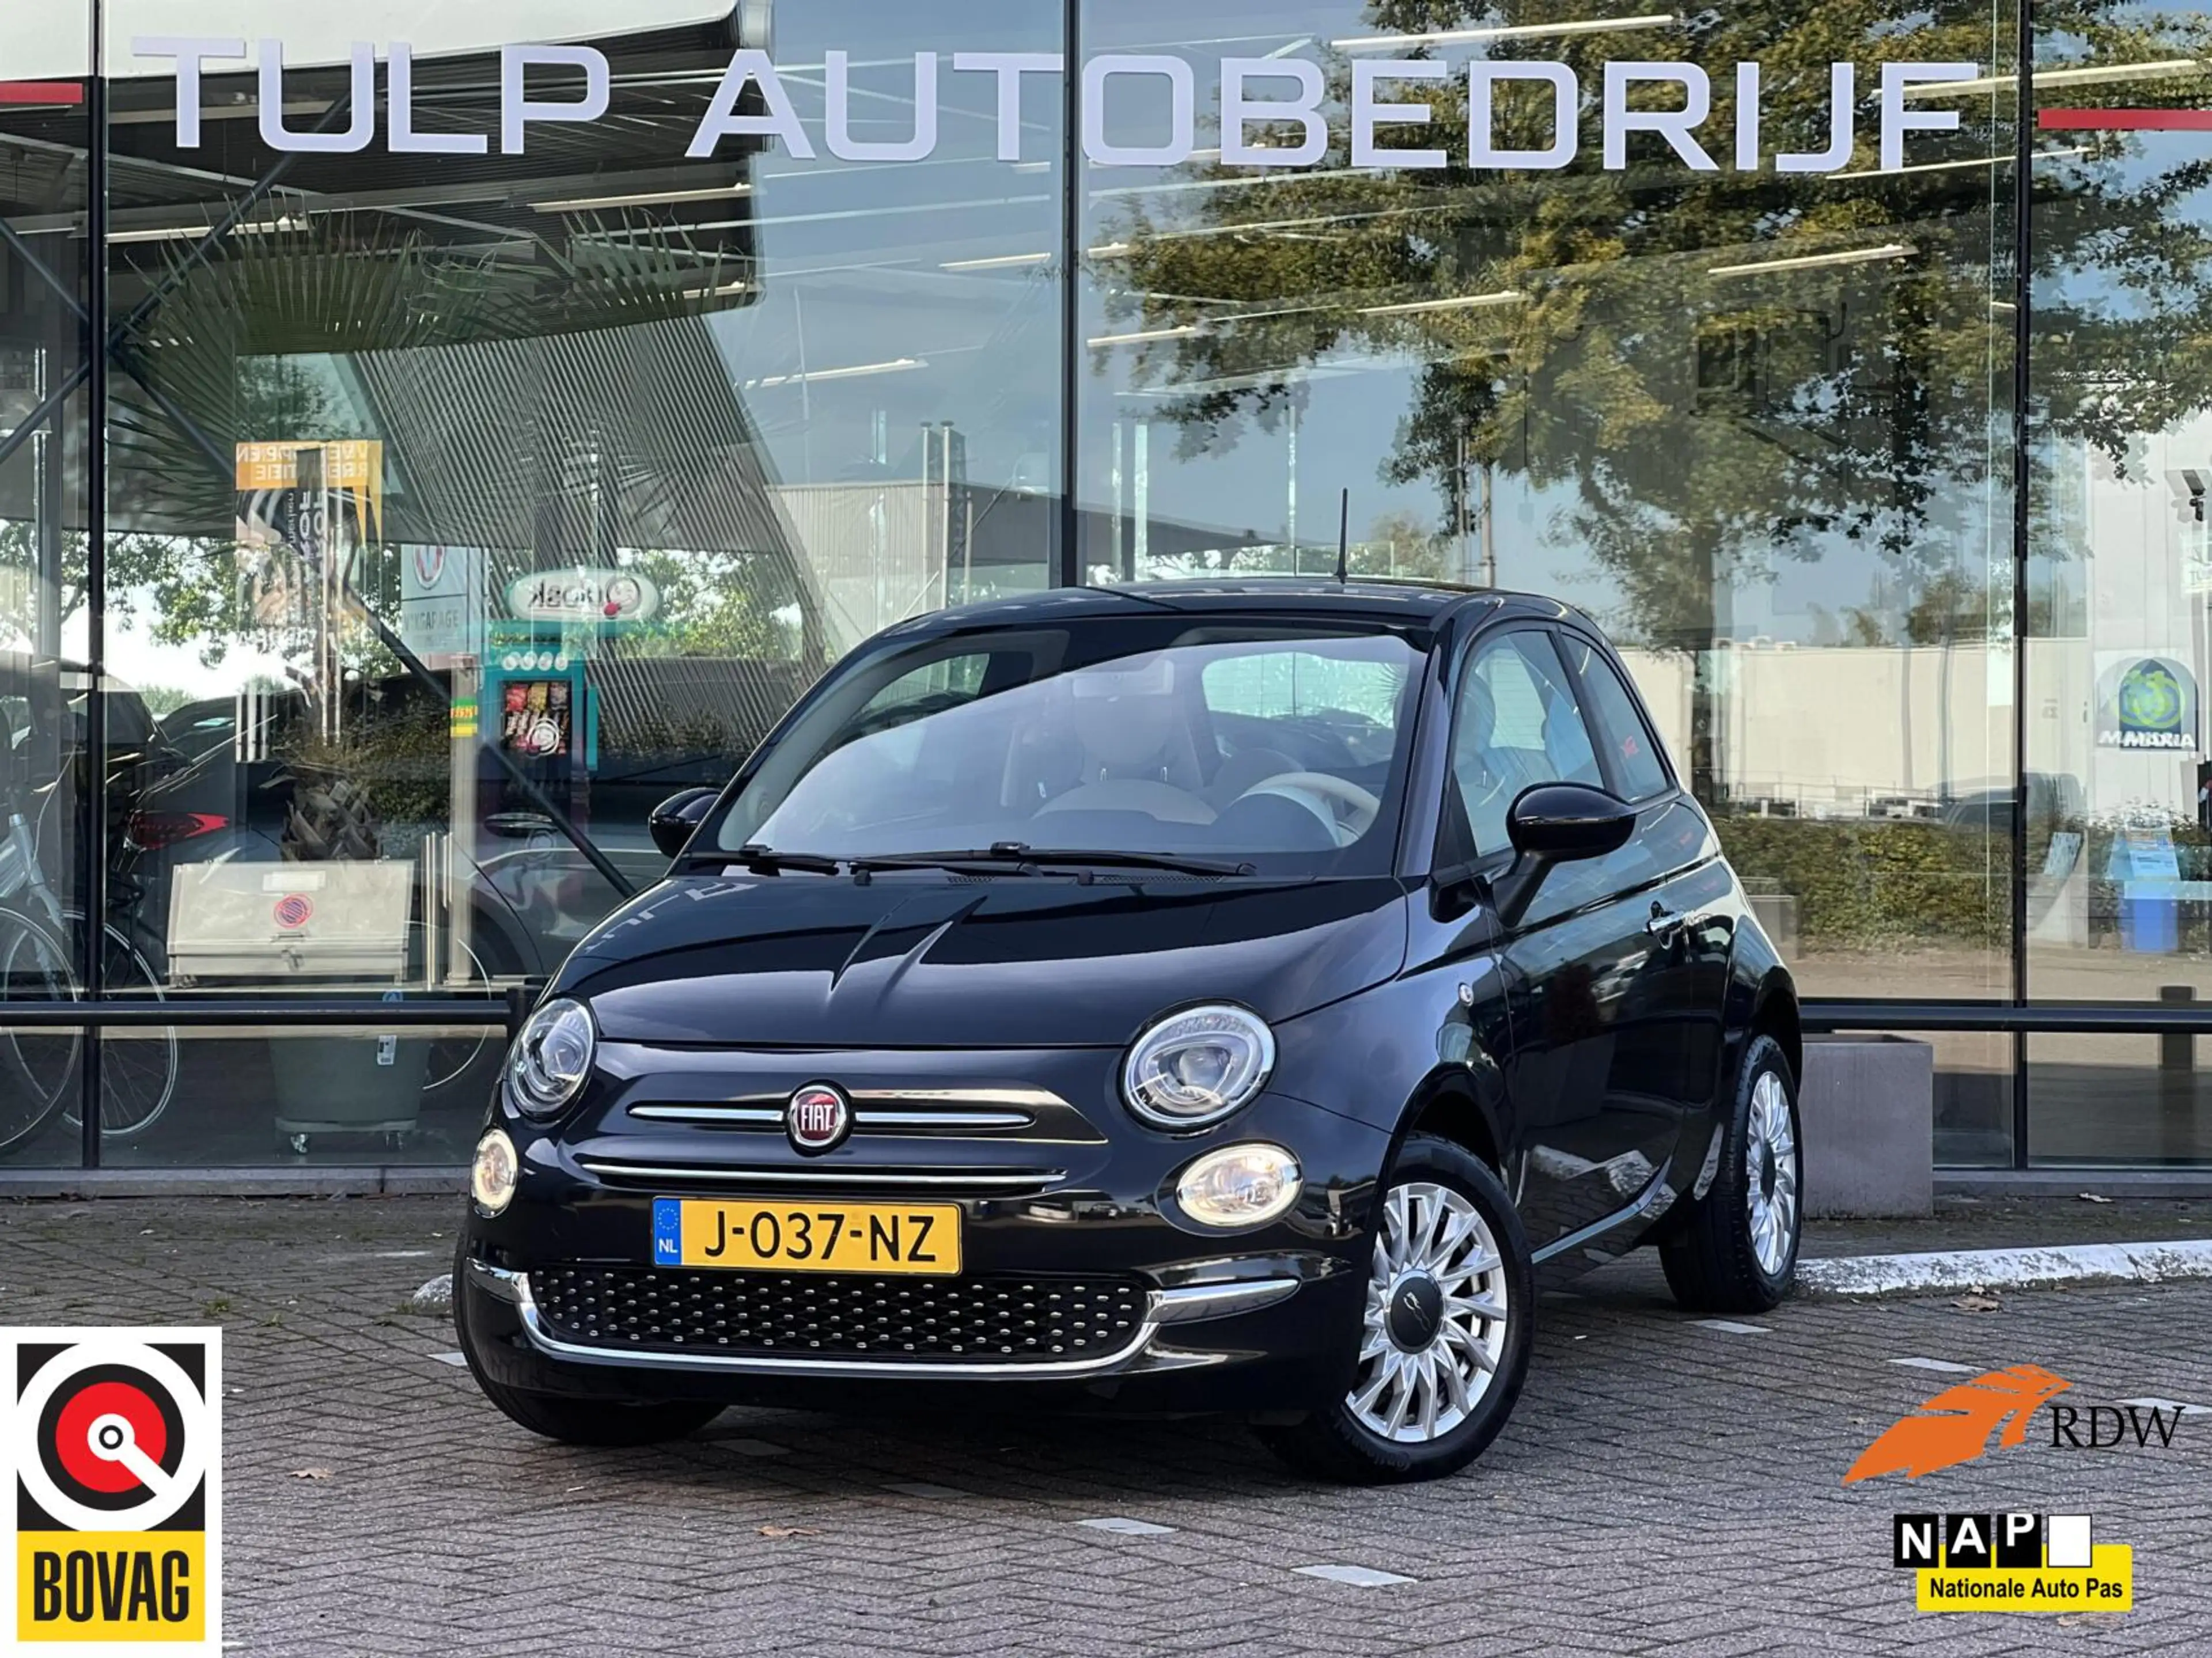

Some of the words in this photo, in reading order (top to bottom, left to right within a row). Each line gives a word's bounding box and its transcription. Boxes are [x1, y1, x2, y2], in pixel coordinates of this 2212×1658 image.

[131, 35, 611, 155] TULP
[684, 47, 1980, 174] AUTOBEDRIJF
[801, 1104, 834, 1131] FIAT
[658, 1239, 678, 1254] NL
[704, 1210, 937, 1262] J-037-NZ
